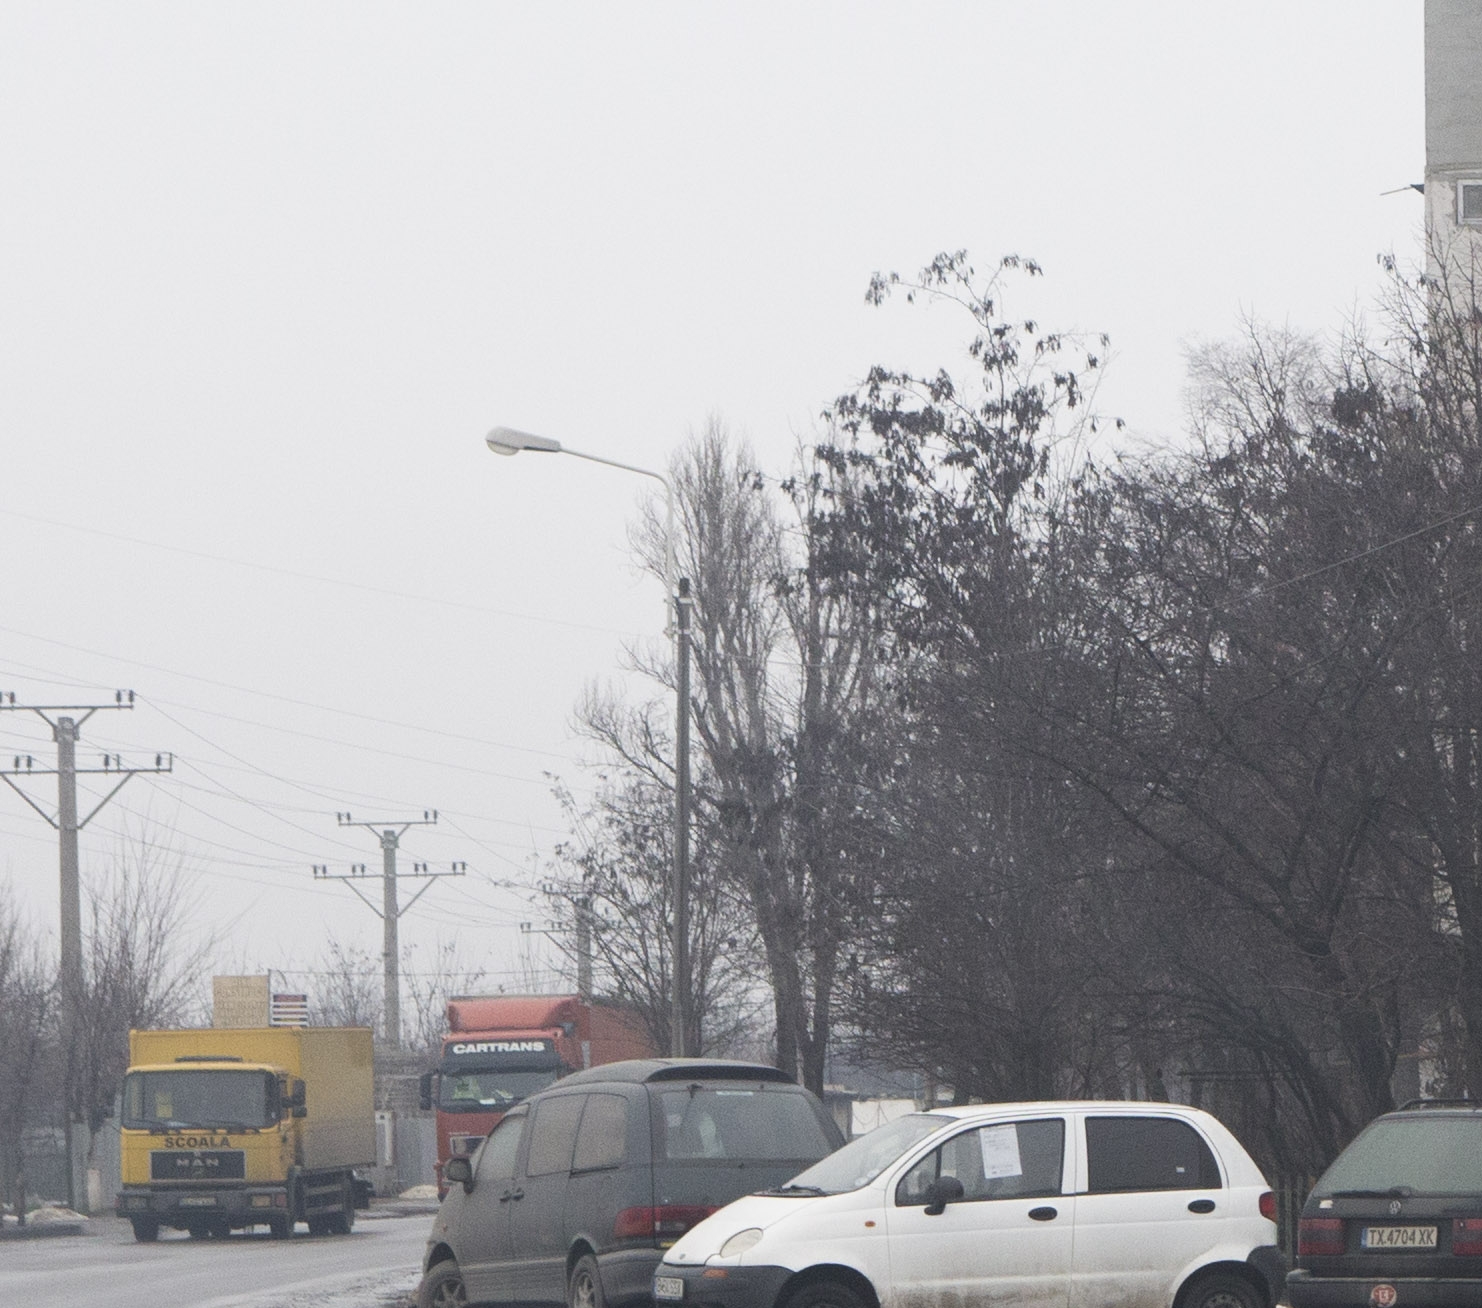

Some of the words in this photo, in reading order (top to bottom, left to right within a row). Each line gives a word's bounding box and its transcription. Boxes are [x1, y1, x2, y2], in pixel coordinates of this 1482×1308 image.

[453, 1041, 545, 1054] CARTRANS
[164, 1137, 231, 1149] SCOALA
[176, 1158, 219, 1167] MAN
